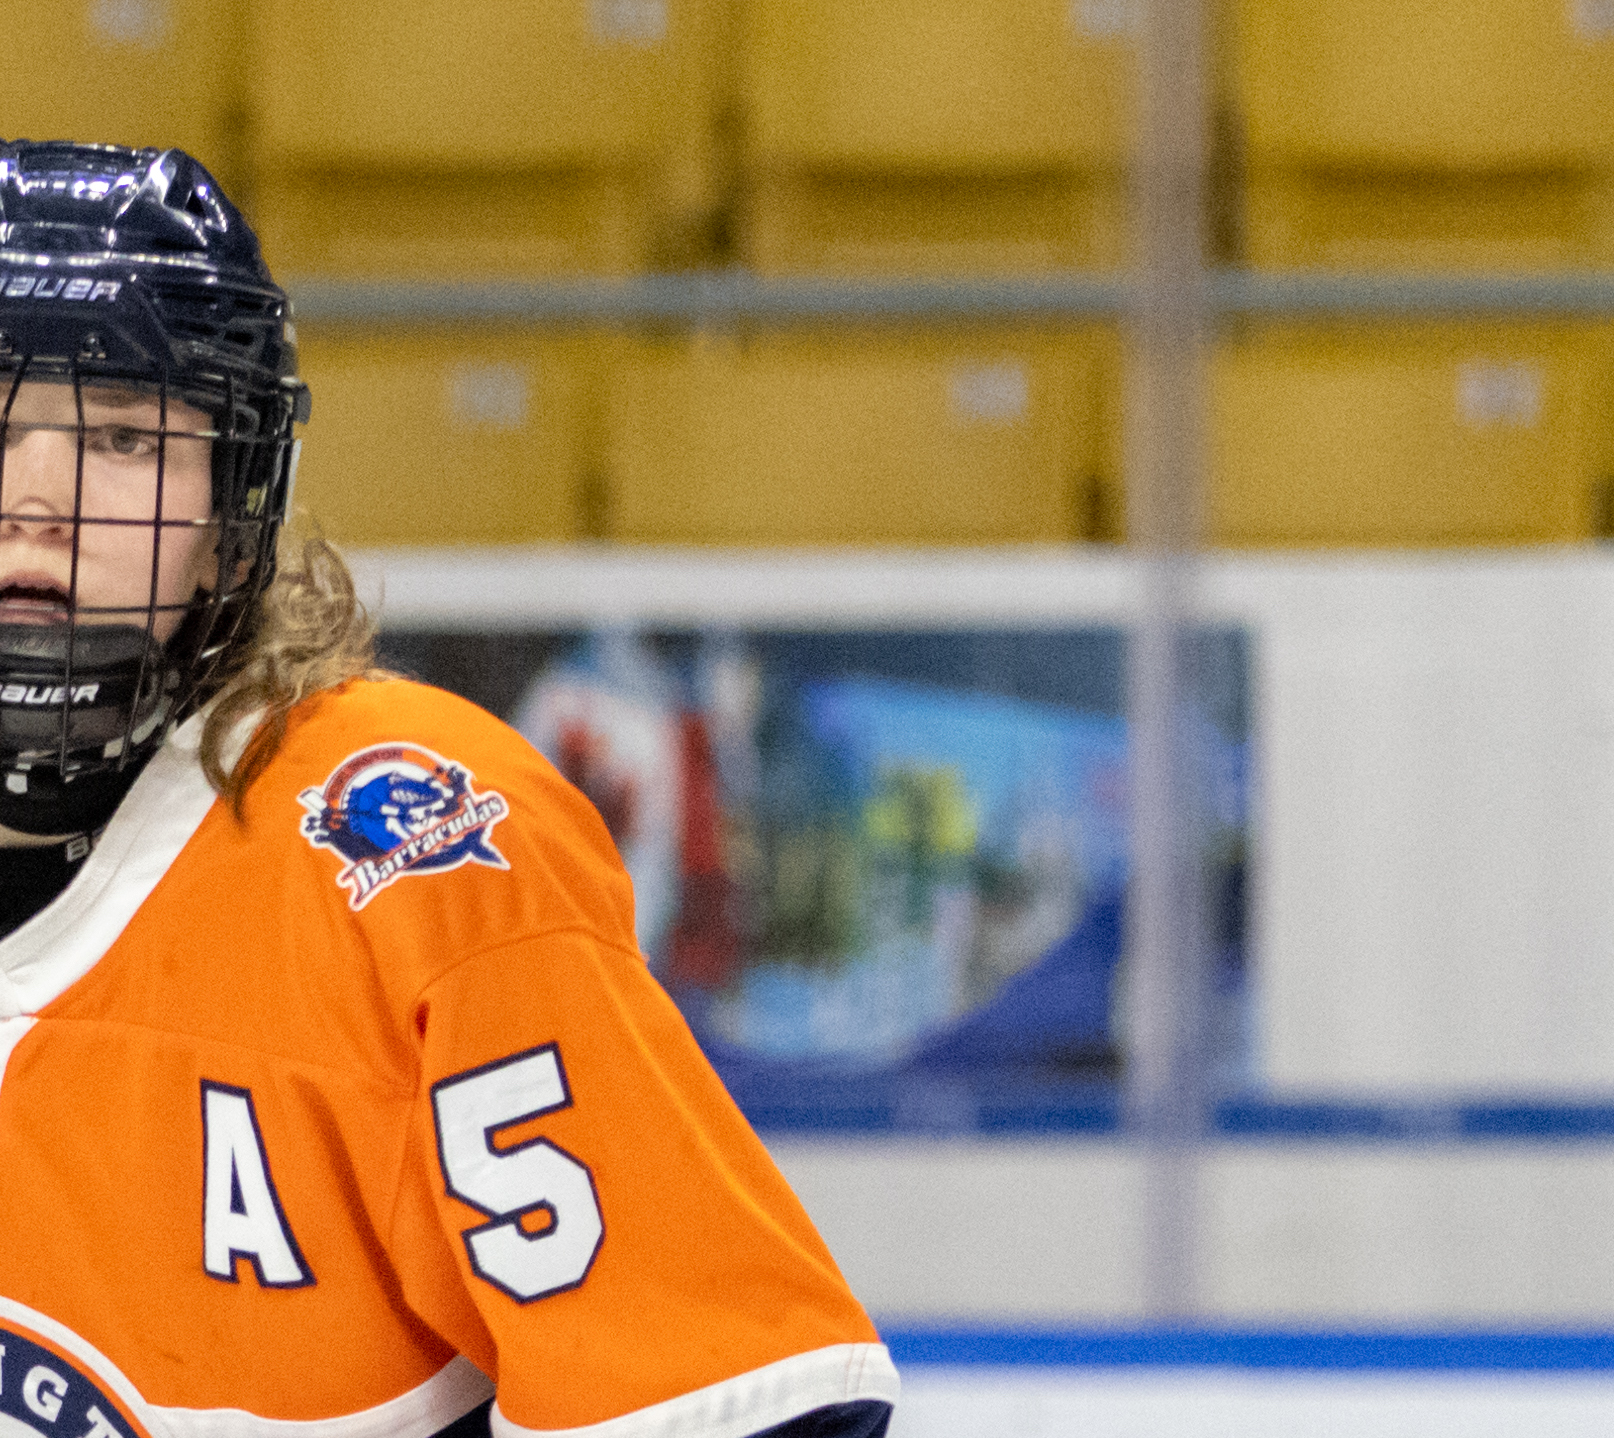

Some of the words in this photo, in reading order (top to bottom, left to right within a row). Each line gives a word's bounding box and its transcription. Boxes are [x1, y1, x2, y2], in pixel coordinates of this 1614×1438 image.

[353, 796, 503, 897] Barracudas
[199, 1077, 318, 1289] A
[429, 1041, 606, 1306] 5
